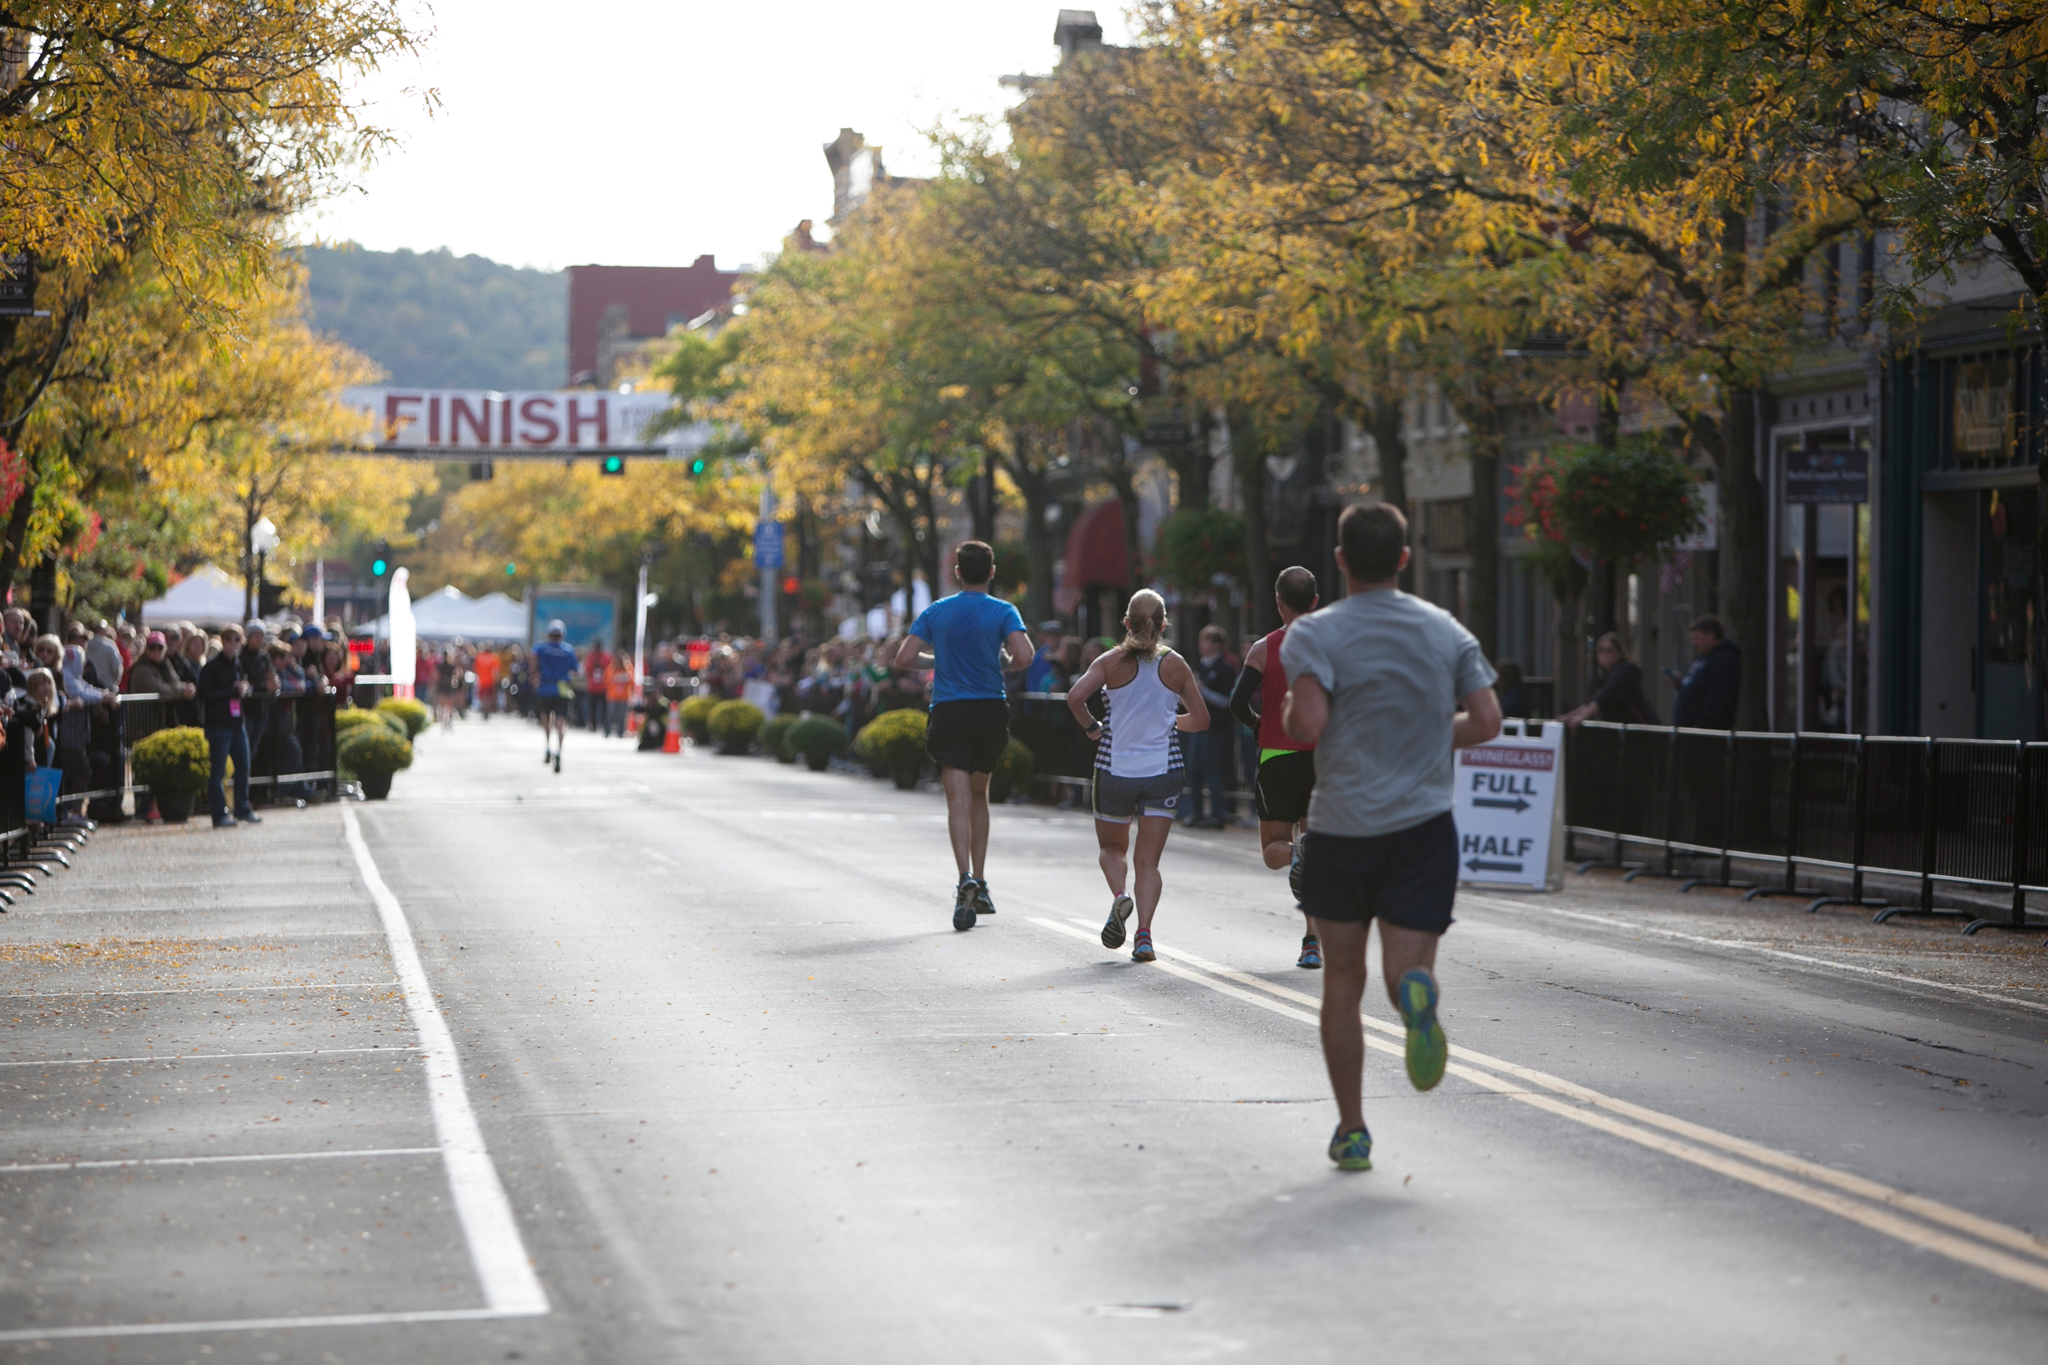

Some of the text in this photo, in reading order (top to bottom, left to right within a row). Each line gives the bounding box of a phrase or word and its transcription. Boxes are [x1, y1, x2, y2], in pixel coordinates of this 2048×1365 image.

[385, 395, 609, 446] FINISH
[1469, 749, 1546, 766] WINEGLASS
[1472, 773, 1537, 795] FULL
[1463, 834, 1533, 857] HALF
